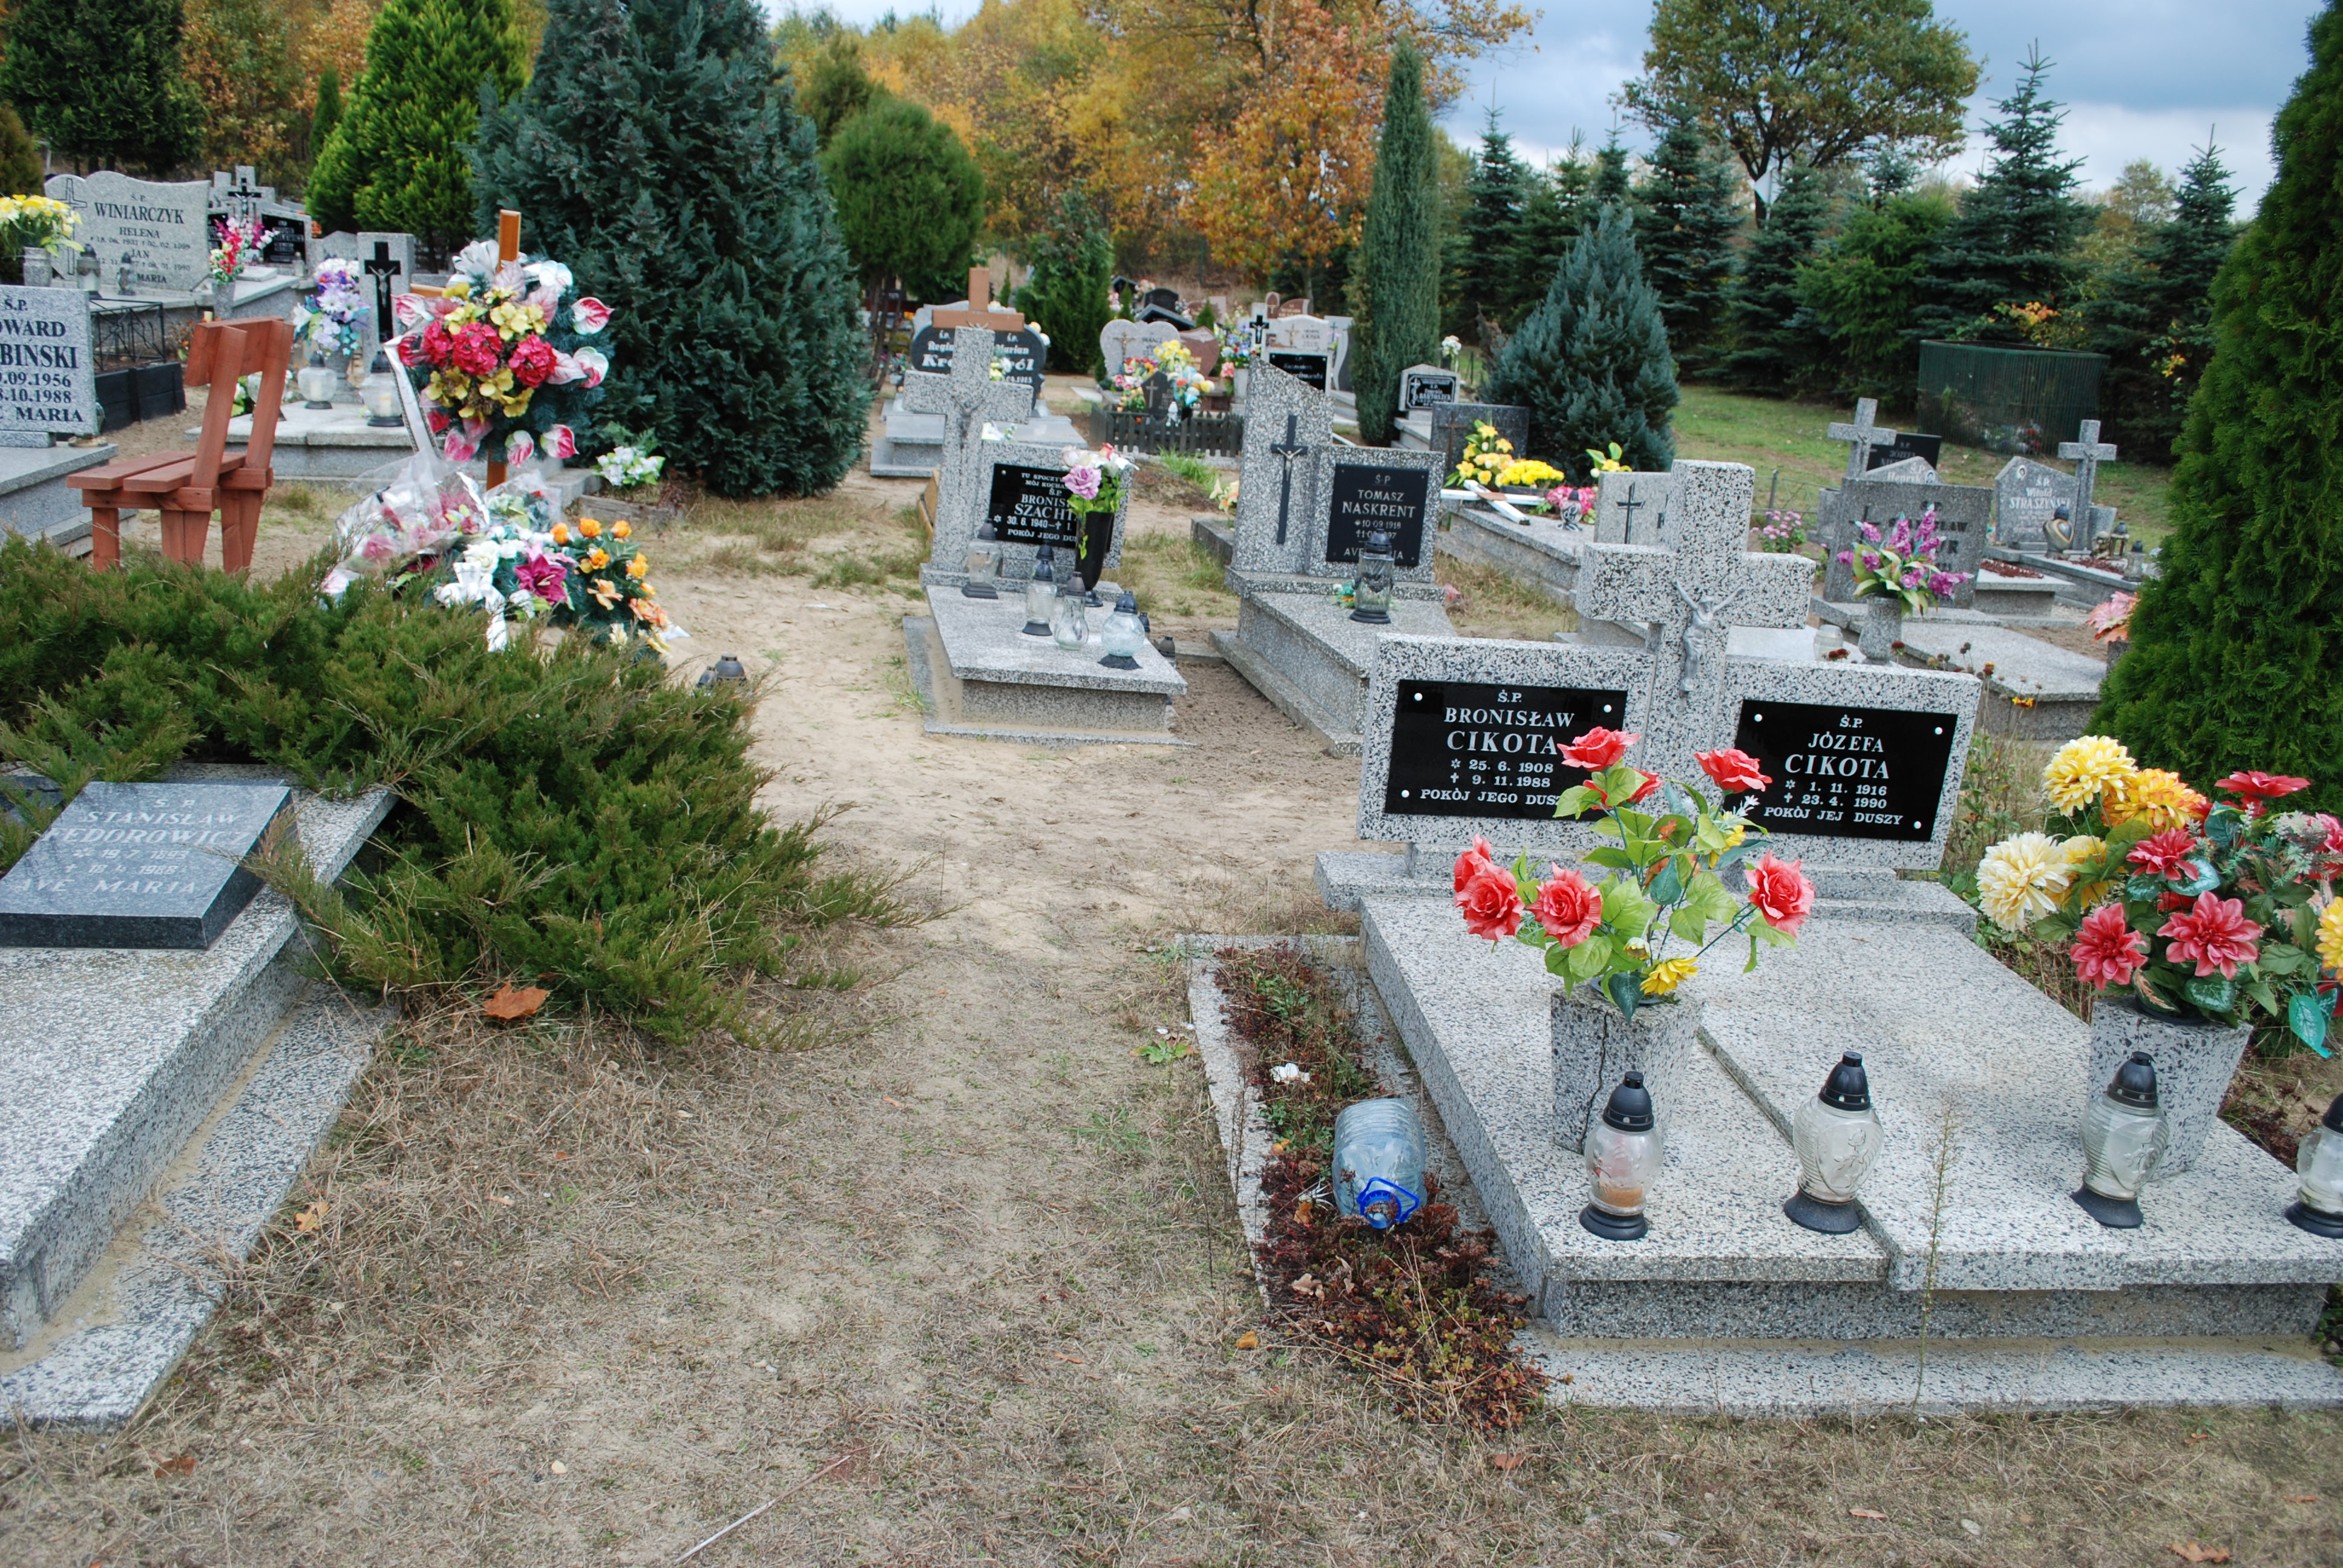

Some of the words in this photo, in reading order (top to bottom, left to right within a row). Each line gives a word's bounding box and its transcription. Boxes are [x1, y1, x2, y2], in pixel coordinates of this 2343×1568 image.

[94, 202, 185, 224] WINIARCZYK
[120, 226, 160, 239] HELENA
[131, 249, 149, 258] JAN
[137, 273, 167, 283] MARIA
[4, 295, 28, 311] Ś.P.
[15, 407, 85, 422] MARIA
[1357, 489, 1404, 502] TOMASZ
[2026, 488, 2053, 497] Witold
[1021, 494, 1070, 508] BRONIS
[1014, 503, 1077, 521] SZACHT
[1342, 501, 1417, 518] NASKRENT
[1007, 528, 1035, 537] POKÓJ
[1037, 531, 1060, 540] JEGO
[1498, 689, 1522, 703] Ś.P.
[1444, 707, 1575, 727] BRONISŁAW
[1840, 714, 1863, 728] Ś.P.
[1447, 730, 1558, 755] CIKOTA
[1808, 731, 1884, 753] JÓZEFA
[1469, 759, 1490, 771] 25.
[1498, 761, 1511, 771] 6.
[1519, 762, 1553, 773] 1908
[1785, 754, 1889, 779] CIKOTA
[1472, 774, 1486, 785] 9.
[1516, 776, 1550, 788] 1988
[1420, 787, 1469, 802] POKÓJ
[1477, 791, 1518, 804] JEGO
[1810, 782, 1821, 791] 1.
[1830, 783, 1847, 793] 11.
[1855, 785, 1887, 796] 1916
[1801, 794, 1823, 805] 23.
[1829, 795, 1844, 806] 4.
[1853, 797, 1887, 809] 1990
[81, 811, 241, 825] STANISŁAW
[1763, 805, 1810, 819] POKÓJ
[1817, 811, 1844, 822] JEJ
[1853, 812, 1903, 825] DUSZY
[42, 827, 251, 846] FEDOROWICZ
[16, 879, 75, 892] AVE
[93, 880, 196, 894] MARIA
